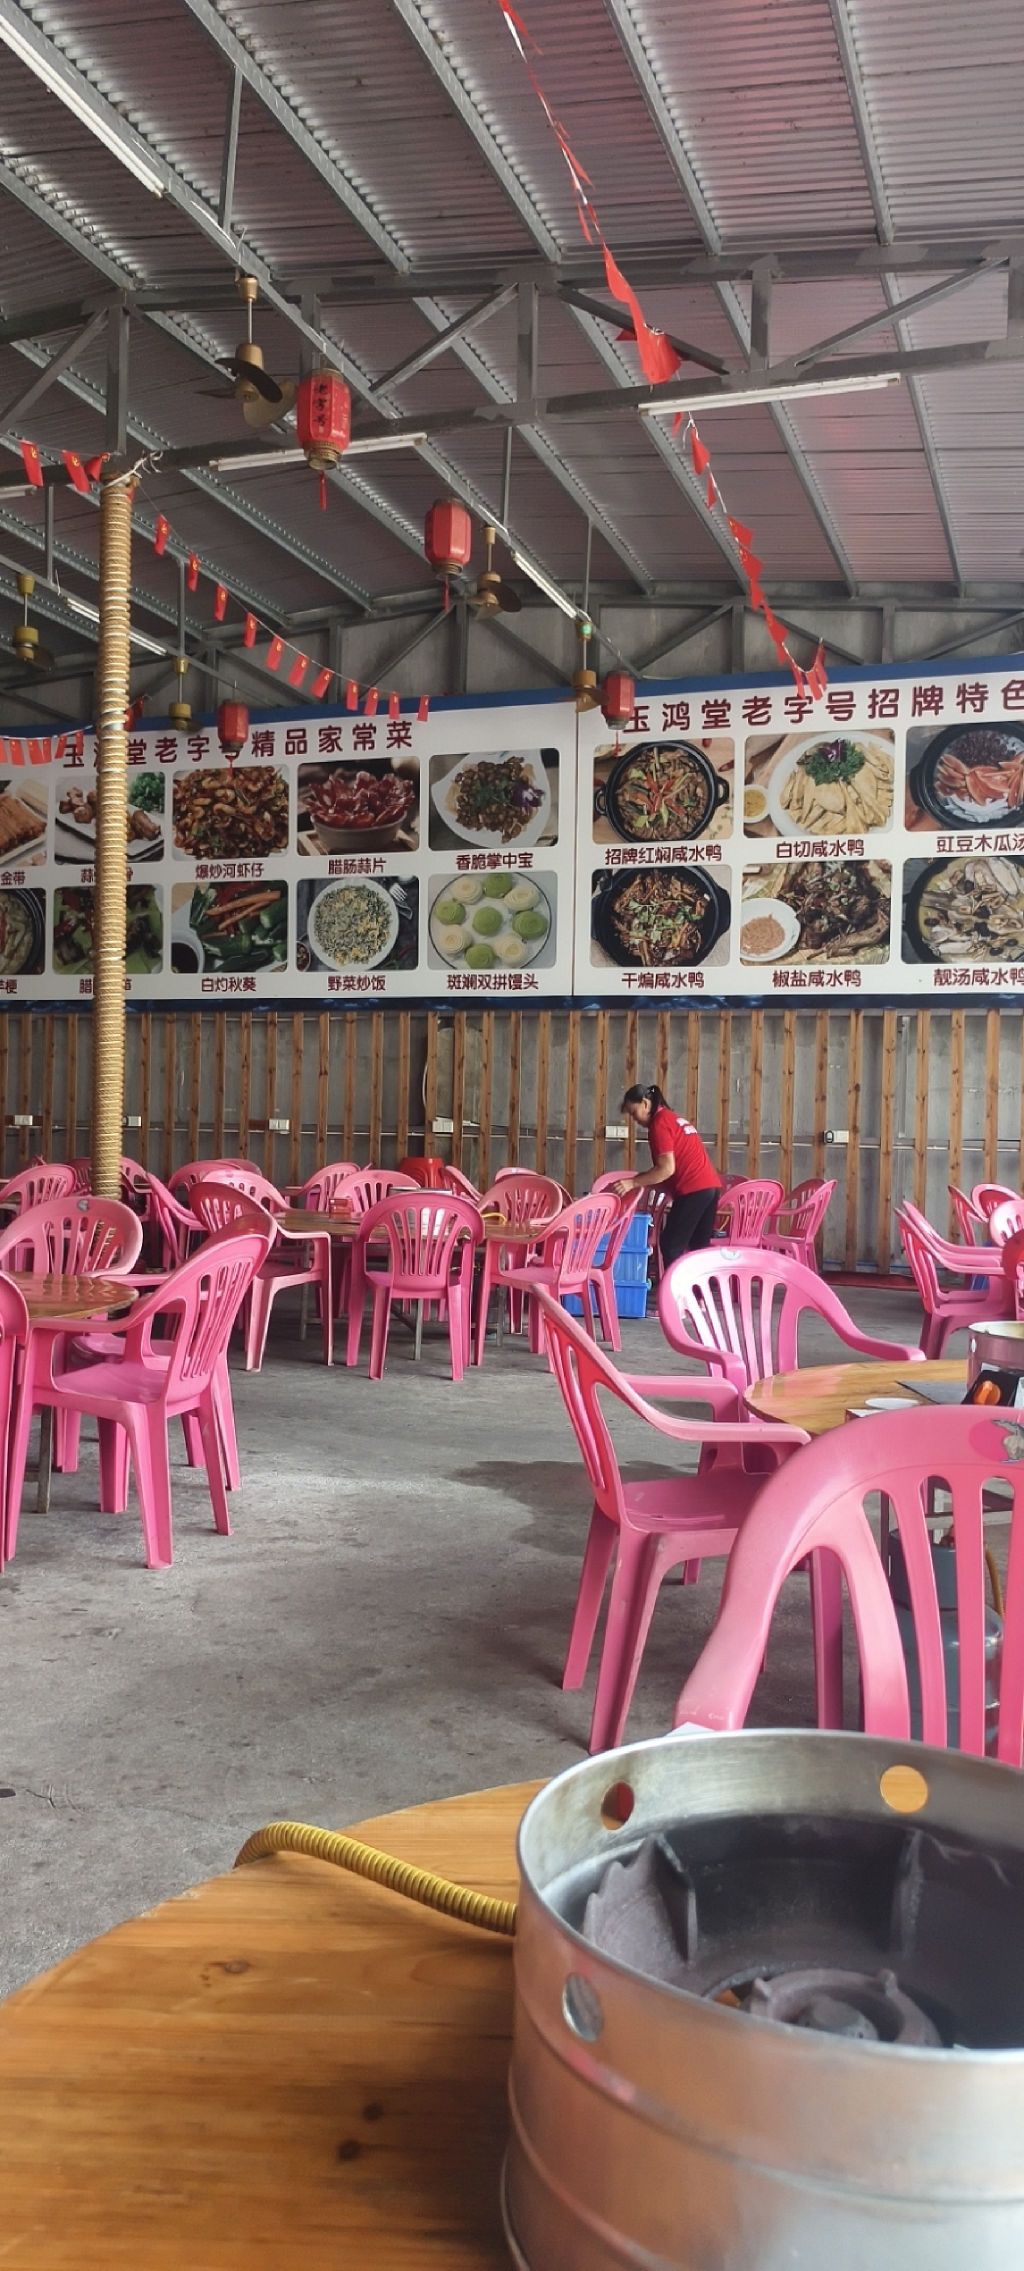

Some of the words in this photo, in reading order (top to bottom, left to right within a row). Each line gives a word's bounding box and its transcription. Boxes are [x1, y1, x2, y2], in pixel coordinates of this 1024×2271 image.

[623, 679, 1024, 733] 玉鸿堂老字号招牌特色
[605, 844, 722, 866] 招牌红焖咸水鸭
[776, 838, 865, 859] 白切咸水鸭
[328, 858, 387, 875] 腊肠蒜片
[455, 852, 534, 871] 香脆掌中宝
[195, 863, 265, 880] 爆炒河虾仔
[201, 977, 257, 992] 白灼秋葵
[327, 975, 386, 992] 野菜炒饭
[447, 973, 539, 990] 斑斓双拼馒头
[621, 972, 705, 989] 干煸咸水鸭
[772, 969, 862, 988] 椒盐咸水鸭
[933, 967, 1024, 987] 靓汤咸水鸭
